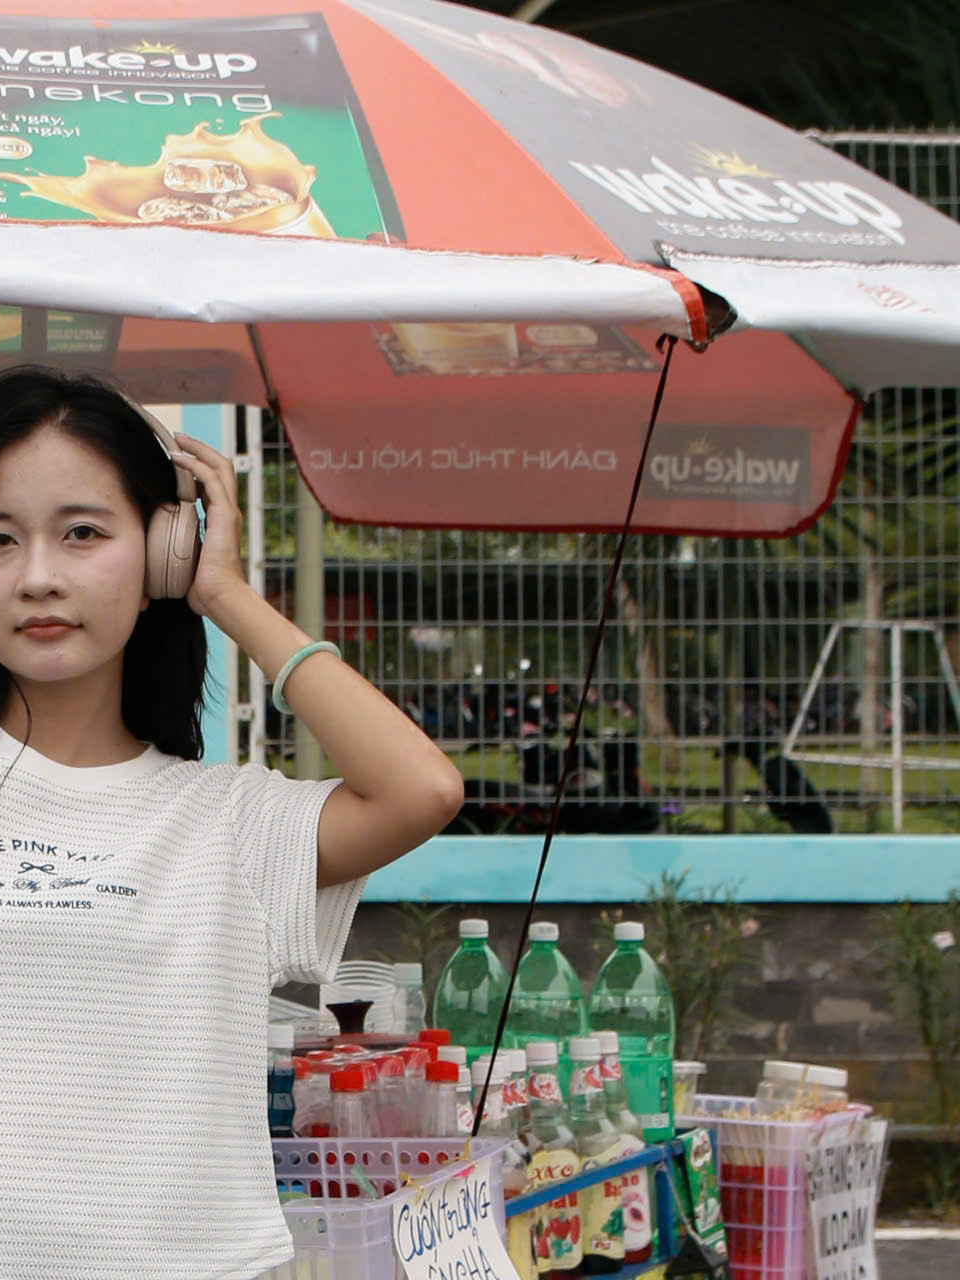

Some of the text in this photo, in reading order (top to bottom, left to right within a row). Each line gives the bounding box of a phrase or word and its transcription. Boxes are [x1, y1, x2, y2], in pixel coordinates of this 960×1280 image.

[12, 840, 58, 856] PINK
[96, 884, 138, 897] GARDEN
[5, 899, 43, 909] ALWAYS
[44, 900, 95, 910] FLAWLESS.
